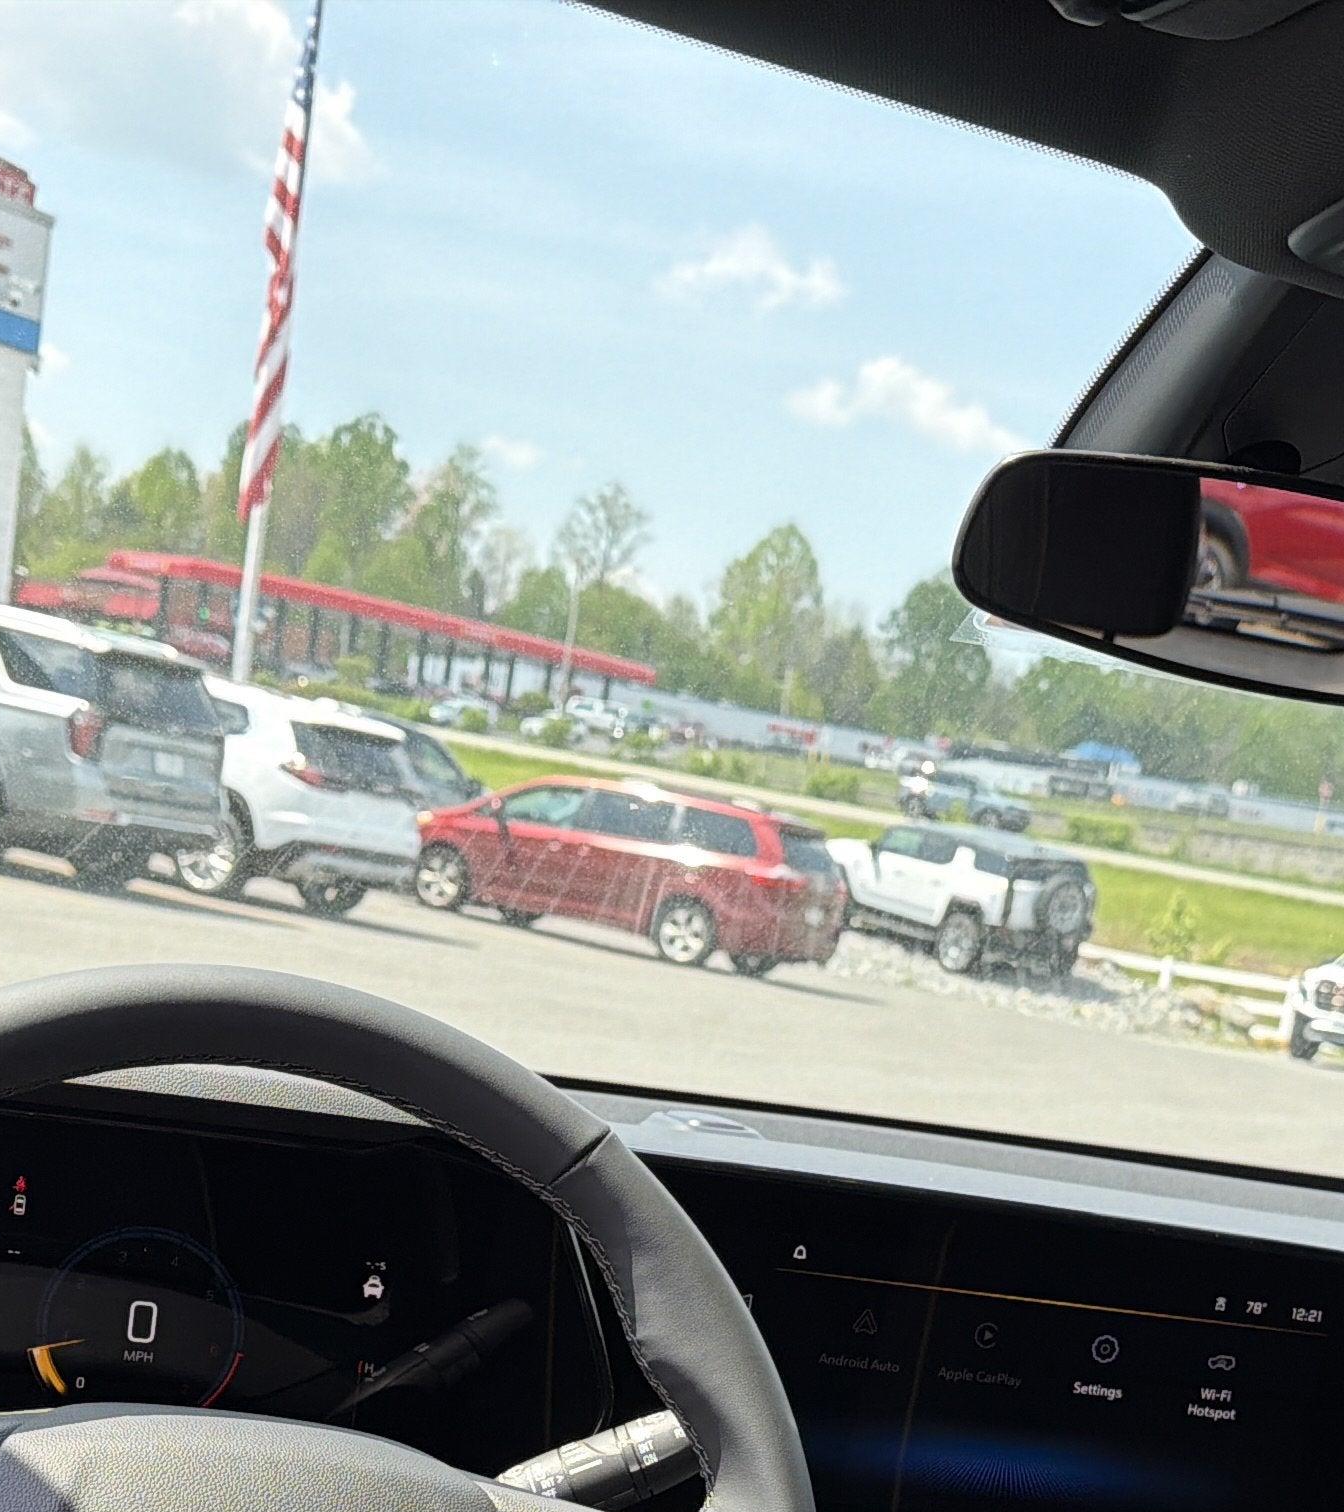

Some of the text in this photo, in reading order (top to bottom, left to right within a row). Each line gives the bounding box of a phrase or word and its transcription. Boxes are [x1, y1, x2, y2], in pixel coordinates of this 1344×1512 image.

[127, 1300, 158, 1344] 0
[1291, 1306, 1324, 1323] 12:21
[123, 1350, 154, 1363] MPH
[818, 1352, 900, 1374] Android Auto
[938, 1366, 1023, 1390] Apple CarPlay
[1073, 1380, 1123, 1401] Settings
[1200, 1387, 1232, 1403] Wi-Fi
[1187, 1403, 1236, 1422] Hotspot
